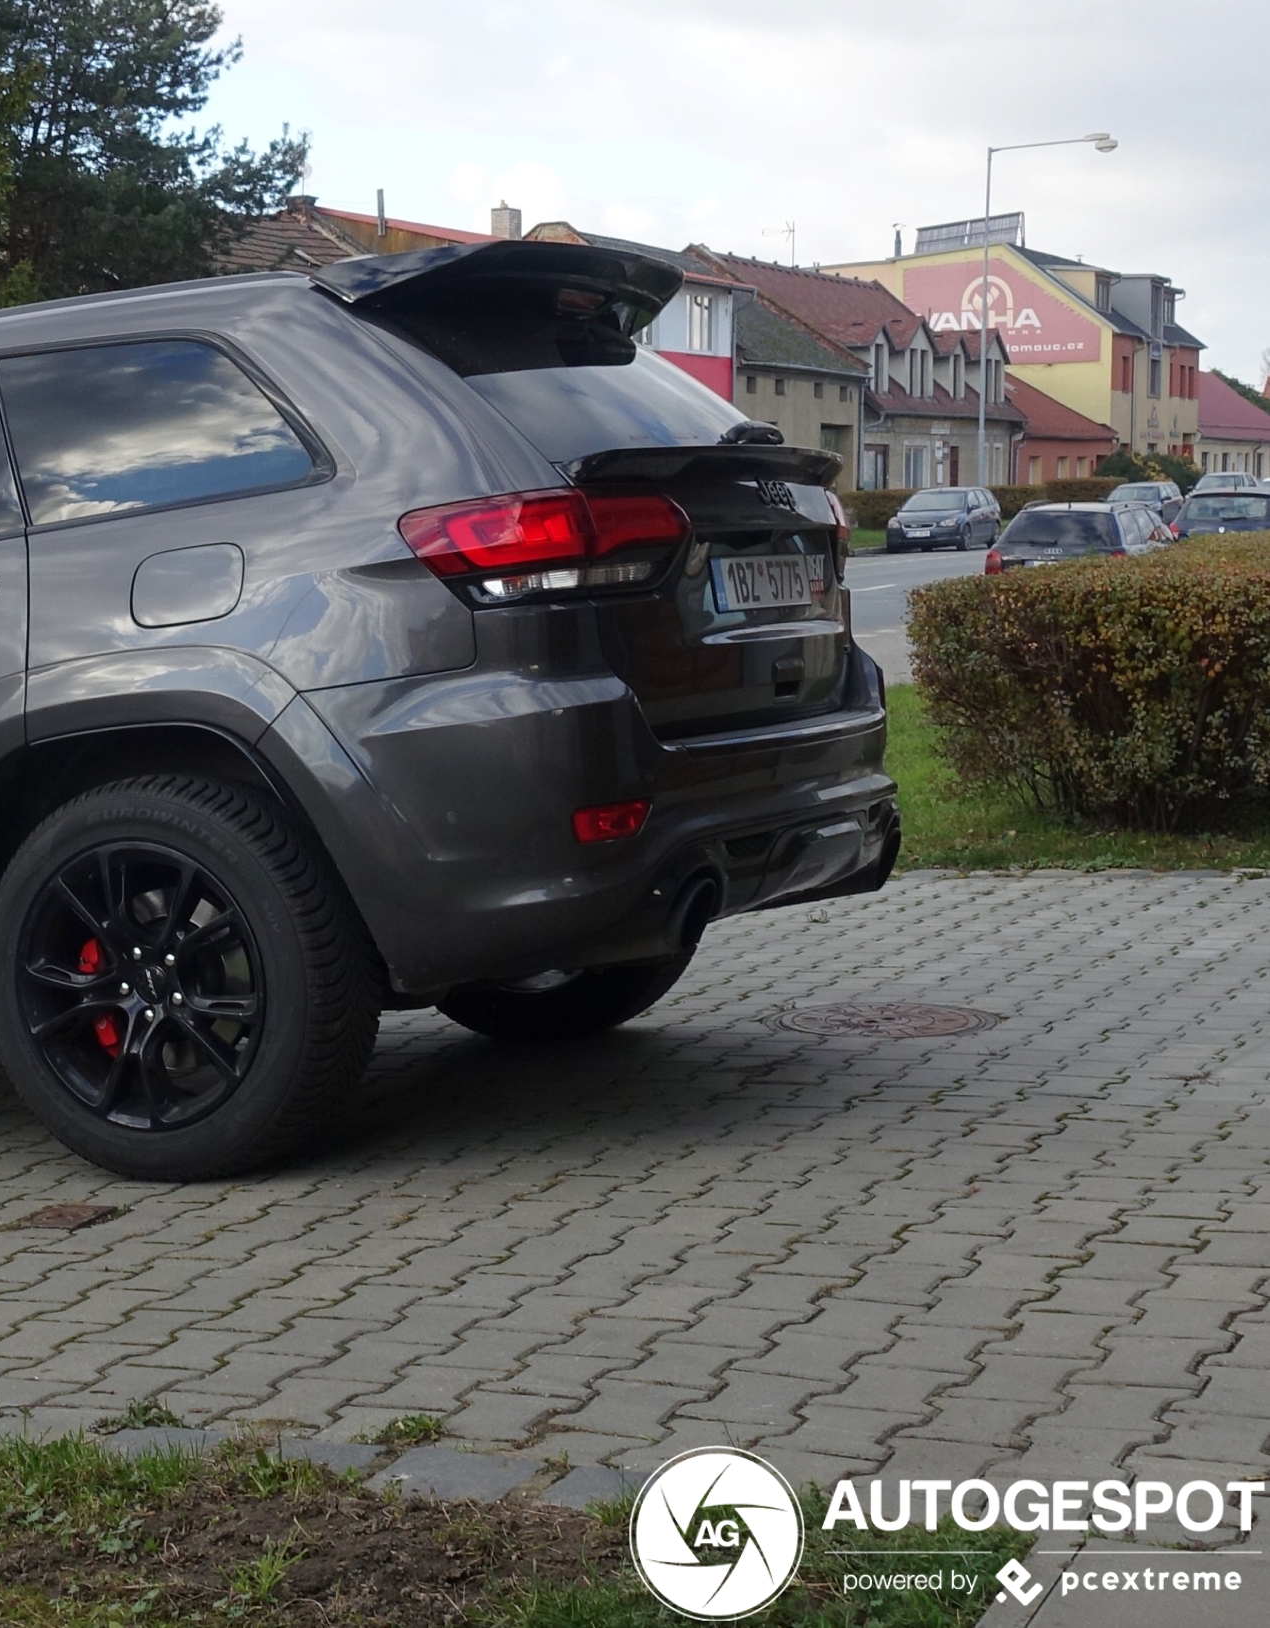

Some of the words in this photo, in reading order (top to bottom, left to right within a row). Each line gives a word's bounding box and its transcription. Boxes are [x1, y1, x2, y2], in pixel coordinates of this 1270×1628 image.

[754, 477, 797, 514] Jeep
[728, 562, 761, 605] 1BZ
[765, 560, 805, 601] 5775
